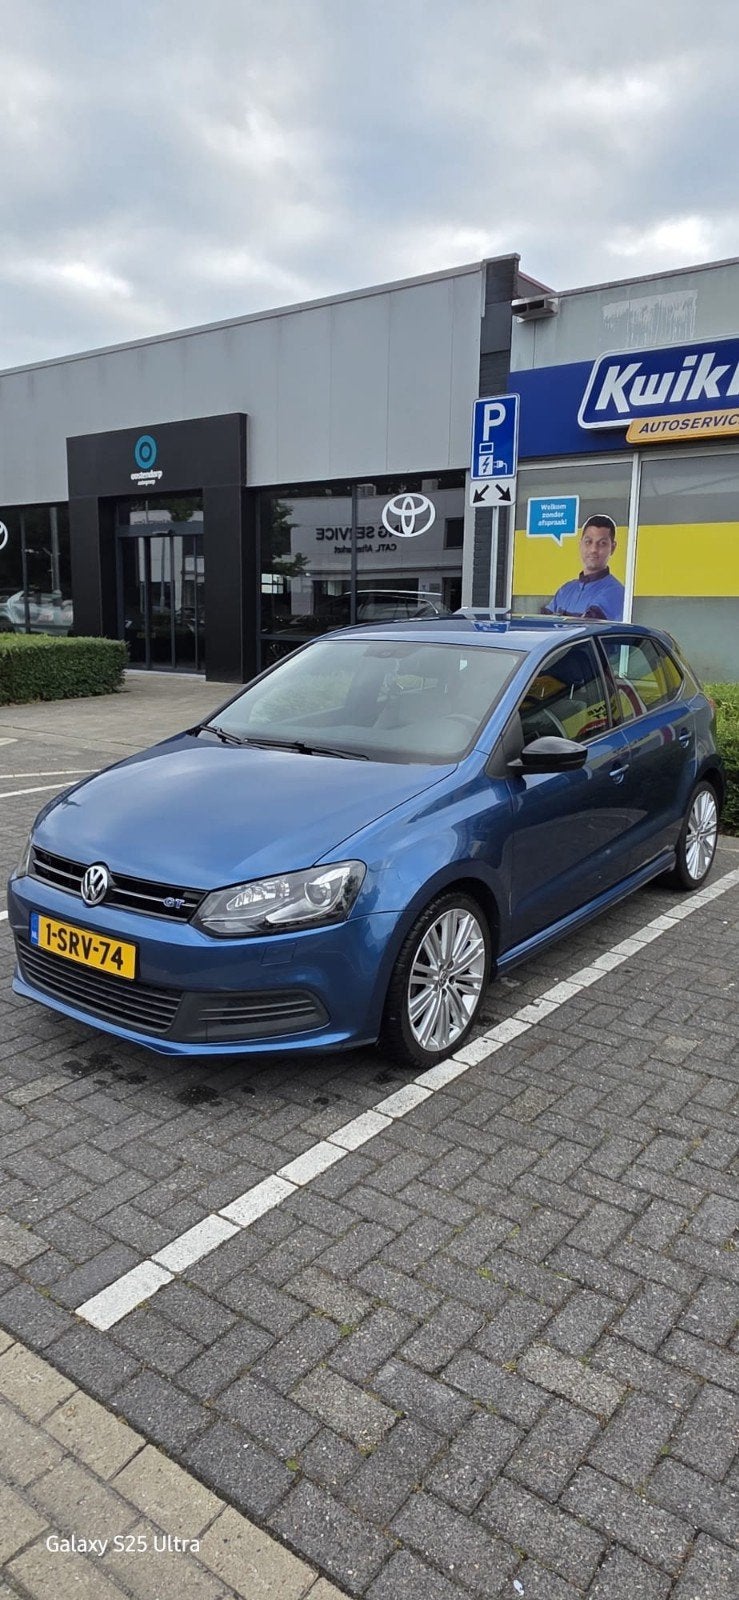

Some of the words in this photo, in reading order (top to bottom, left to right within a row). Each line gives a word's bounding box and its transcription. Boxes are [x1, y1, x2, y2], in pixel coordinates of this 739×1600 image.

[594, 352, 731, 413] Kwik
[483, 403, 506, 441] P
[164, 896, 185, 909] GT
[45, 923, 124, 971] 1-SRV-74
